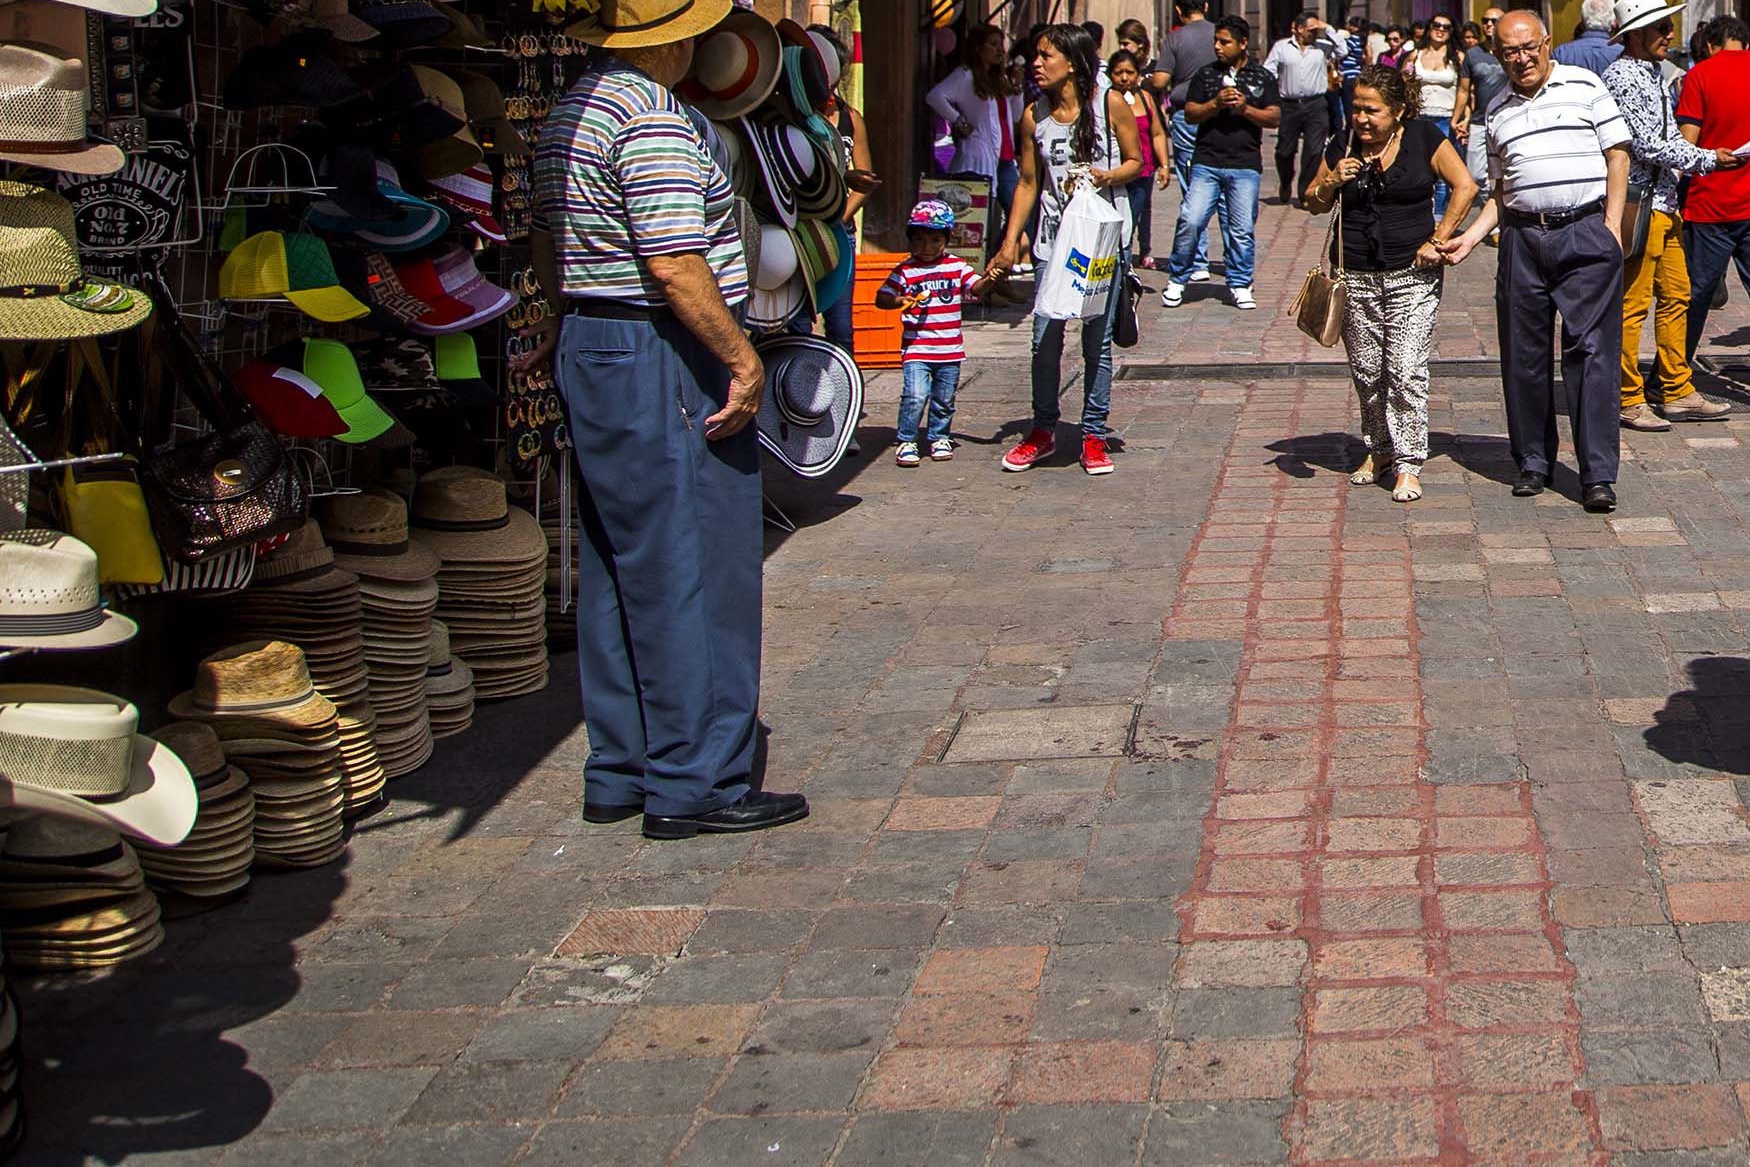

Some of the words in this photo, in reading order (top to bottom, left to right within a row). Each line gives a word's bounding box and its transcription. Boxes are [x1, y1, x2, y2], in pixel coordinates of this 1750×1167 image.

[101, 154, 187, 206] ANIEL'S
[81, 183, 107, 196] OLD
[113, 183, 142, 200] TIME
[94, 206, 126, 221] Old
